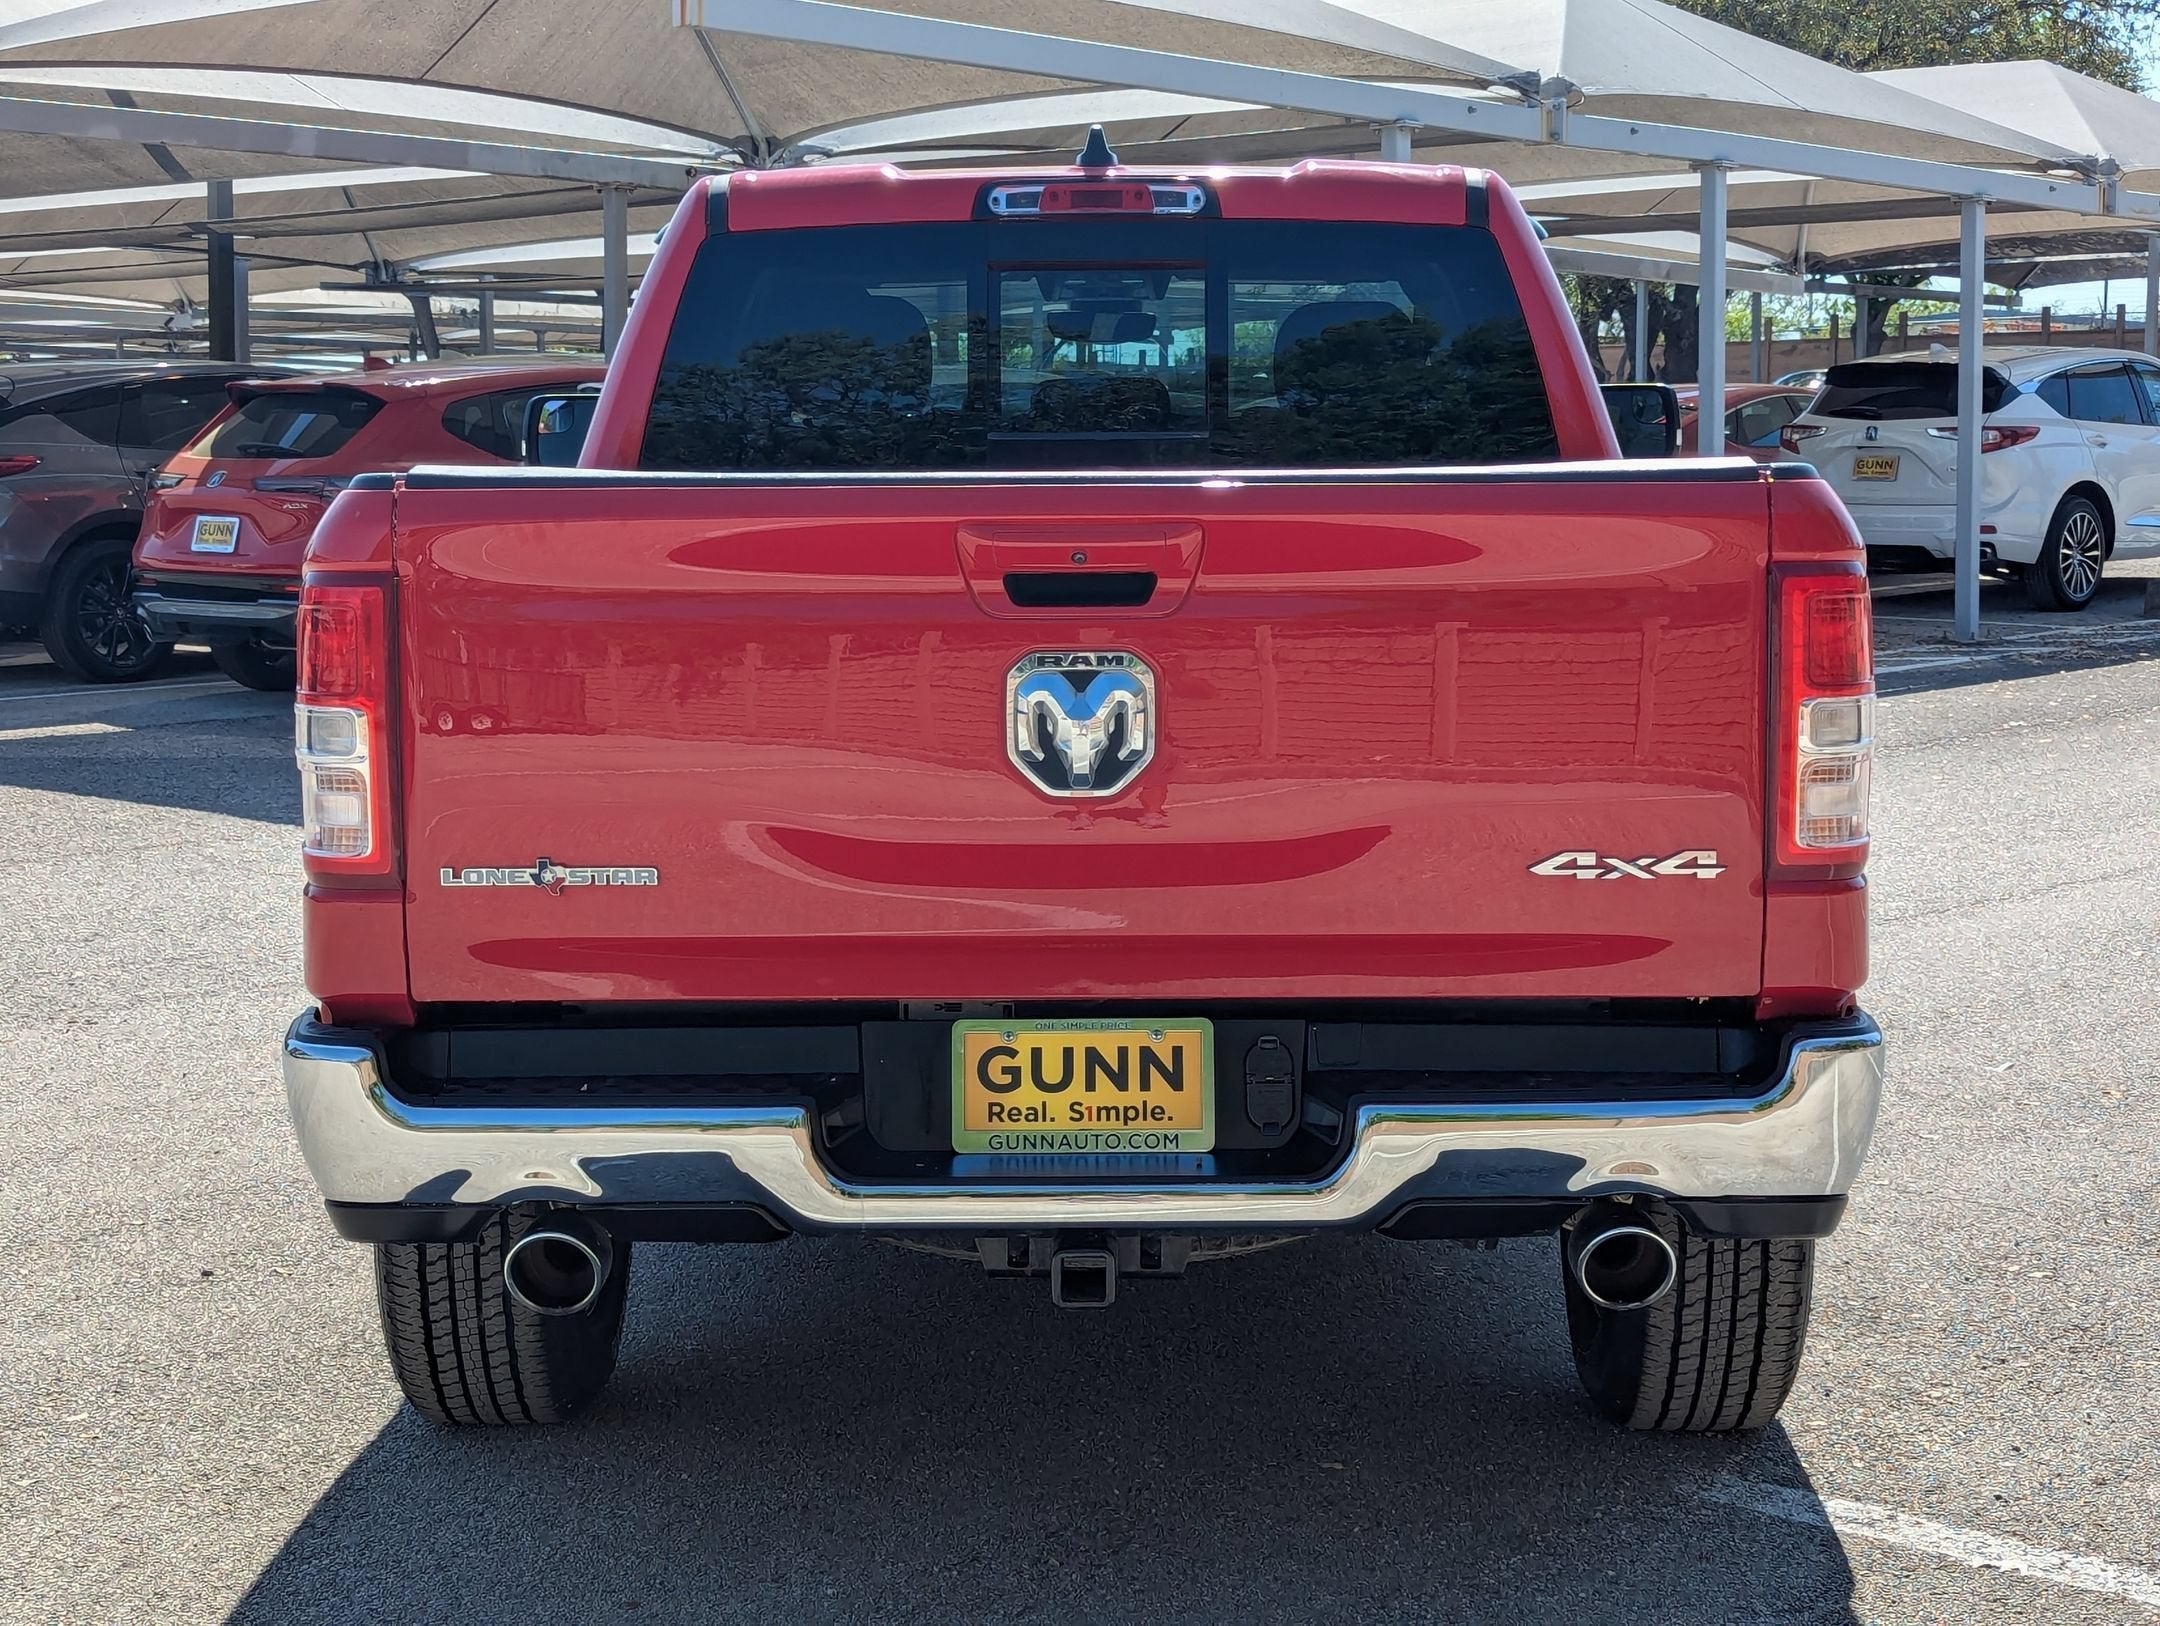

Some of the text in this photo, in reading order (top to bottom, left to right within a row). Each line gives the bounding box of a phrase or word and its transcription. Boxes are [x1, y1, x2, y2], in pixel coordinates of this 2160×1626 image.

[1856, 459, 1894, 470] GUNN
[200, 523, 233, 537] GUNN
[1036, 655, 1125, 667] RAM
[1529, 851, 1727, 880] 4x4
[440, 868, 658, 886] LONE STAR
[1035, 1021, 1131, 1030] ONE SIMPLE PRICE
[976, 1045, 1184, 1094] GUNN
[987, 1101, 1056, 1123] Real.
[988, 1133, 1180, 1151] GUNNAUTO.COM
